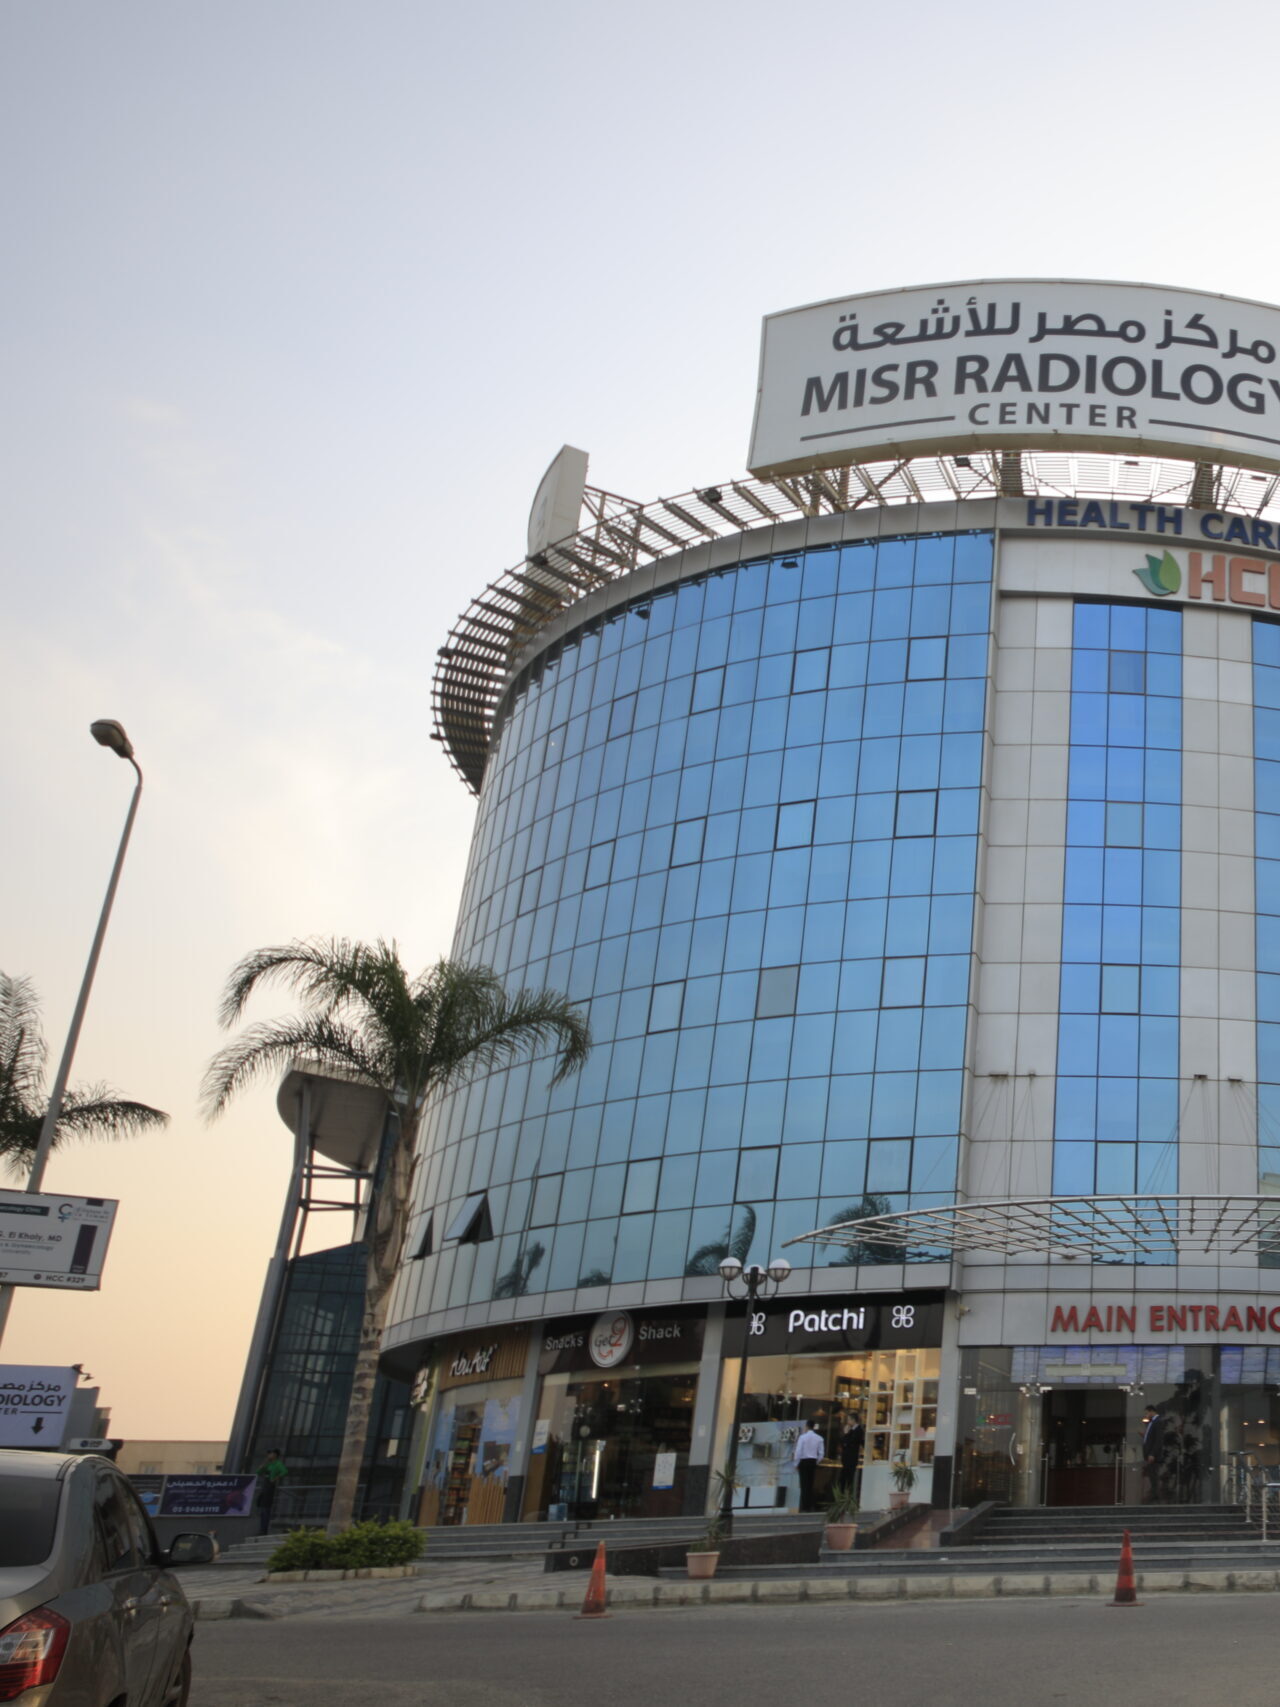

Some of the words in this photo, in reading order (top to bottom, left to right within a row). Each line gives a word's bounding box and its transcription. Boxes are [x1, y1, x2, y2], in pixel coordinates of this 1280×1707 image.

[832, 296, 1021, 352] للأشعة
[1028, 312, 1146, 343] مصر
[1155, 309, 1276, 364] مركز
[800, 359, 939, 417] MISR
[967, 402, 1138, 430] CENTER
[1027, 500, 1183, 535] HEALTH
[788, 1307, 865, 1333] Patchi
[1050, 1305, 1137, 1333] MAIN
[545, 1335, 584, 1351] Snacks
[638, 1324, 682, 1341] Shack
[27, 1381, 62, 1392] مركز
